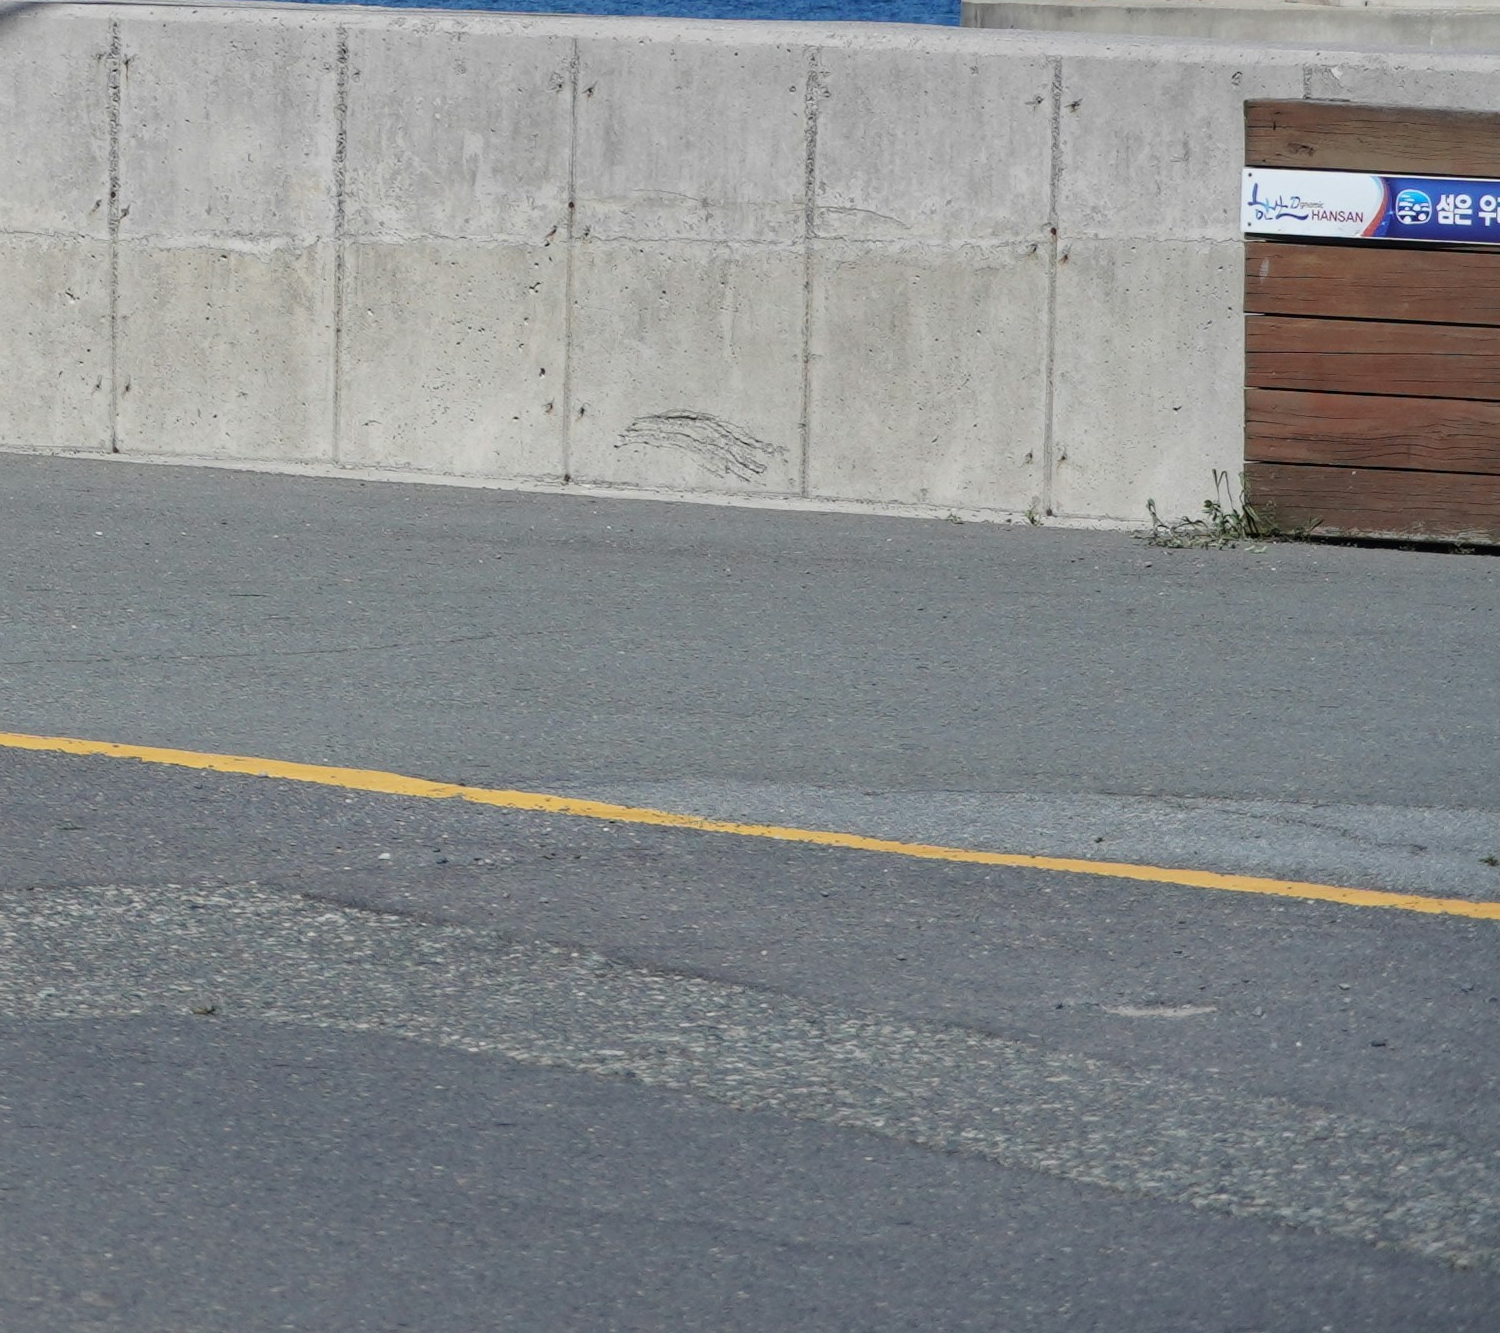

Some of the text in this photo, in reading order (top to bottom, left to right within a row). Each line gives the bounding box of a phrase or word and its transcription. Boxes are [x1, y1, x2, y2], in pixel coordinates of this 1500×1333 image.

[1311, 209, 1364, 223] HANSAN
[1436, 194, 1500, 226] 섬은 우
